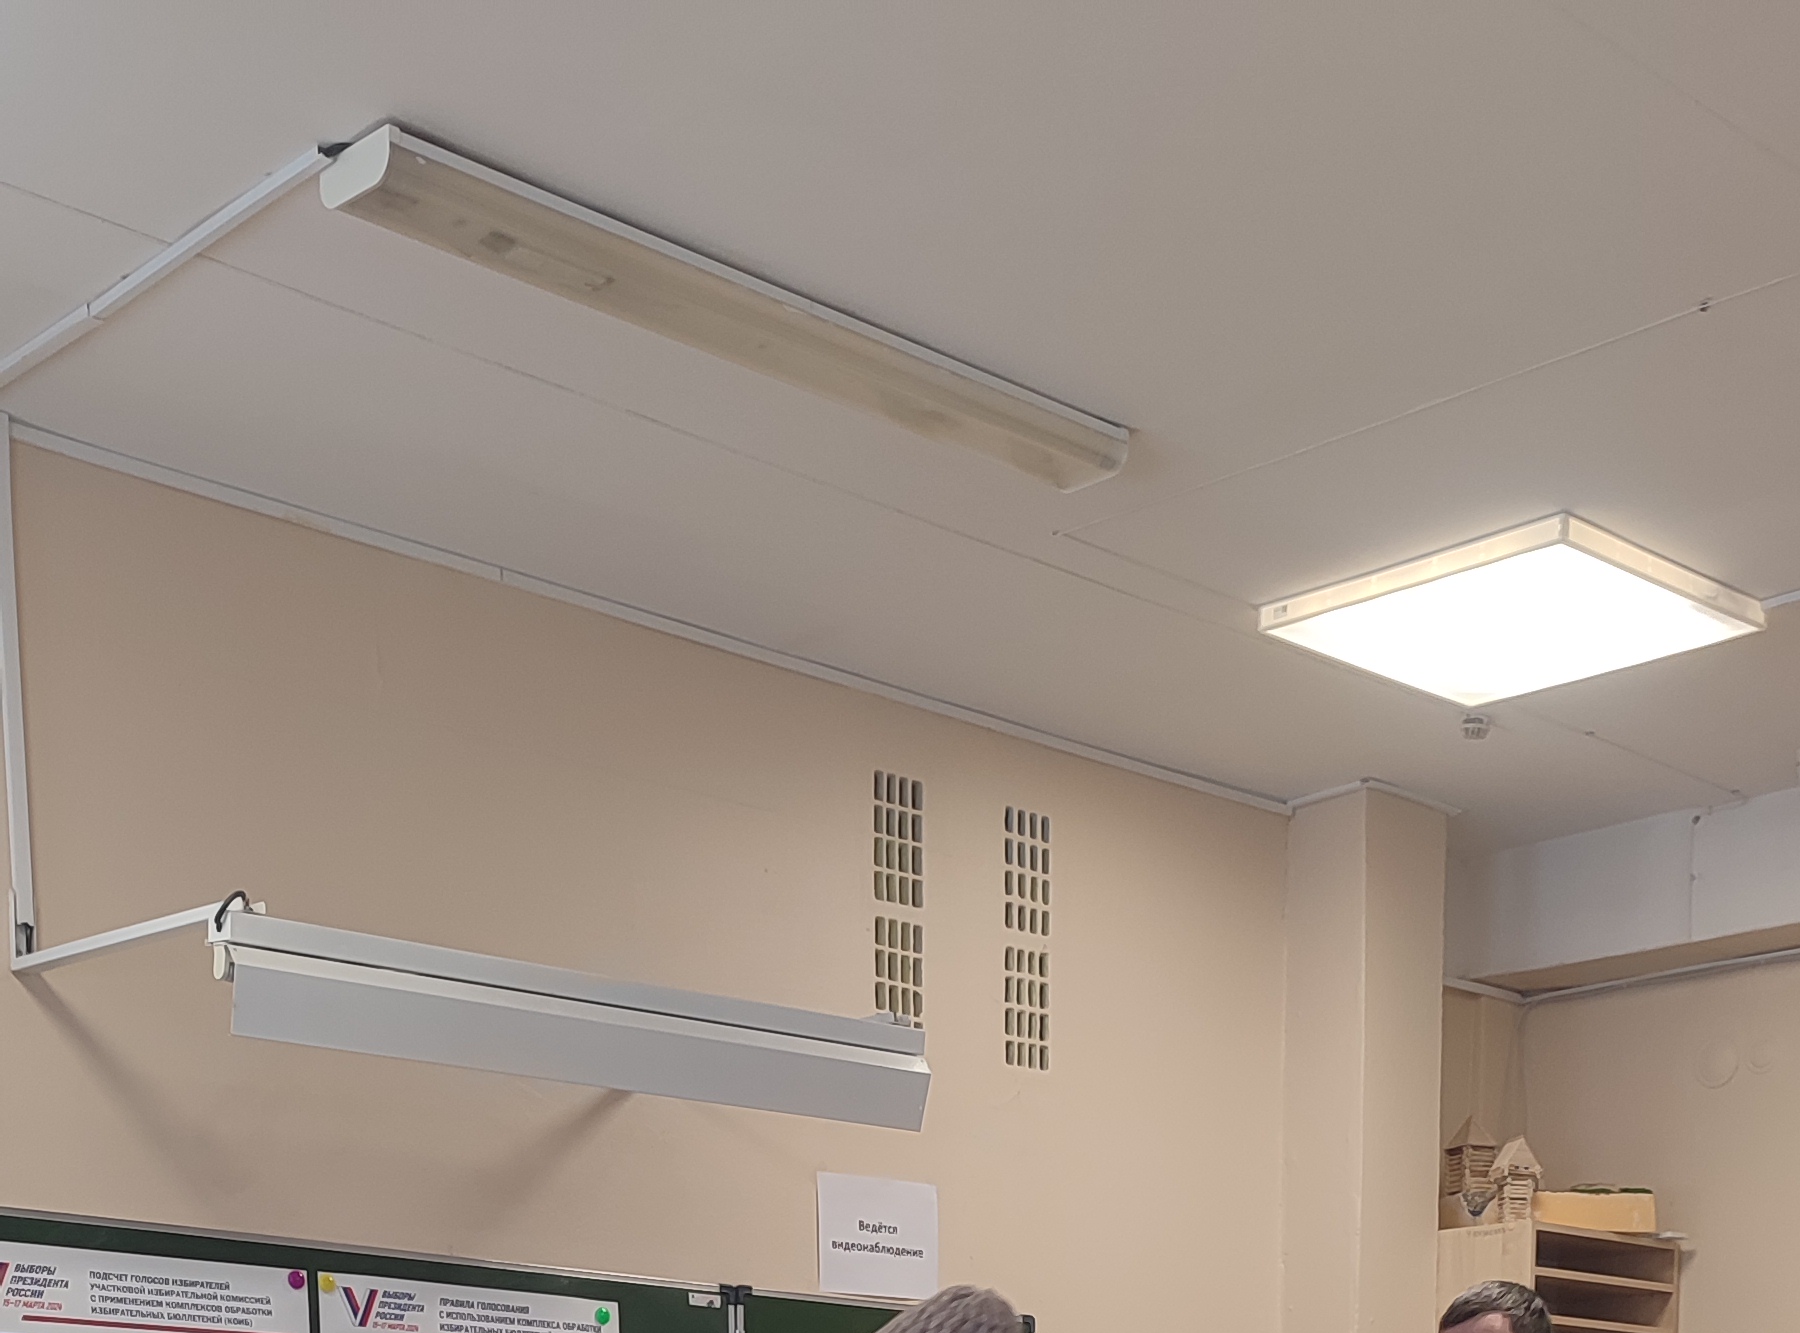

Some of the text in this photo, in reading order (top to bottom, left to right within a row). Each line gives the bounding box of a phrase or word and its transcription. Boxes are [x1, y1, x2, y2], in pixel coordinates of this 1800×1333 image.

[858, 1219, 898, 1235] Ведётся
[831, 1240, 924, 1258] видеонаблюдение
[14, 1263, 57, 1276] ВЫБОРЫ
[9, 1275, 70, 1289] ПРЕЗИДЕНТА
[89, 1270, 230, 1290] ПОДСЧЕТ ГОЛОСОВ ИЗБИРАТЕЛЕЙ
[5, 1287, 45, 1299] РОССИИ
[89, 1283, 271, 1305] УЧАСТКОВОЙ ИЗБИРАТЕЛЬНОЙ КОМИССИЕЙ
[382, 1290, 416, 1301] ВЫБОРЫ
[98, 1295, 163, 1308] ПРИМЕНЕНИЕМ
[165, 1300, 222, 1313] КОМПЛЕКСОВ
[224, 1306, 272, 1317] ОБРАБОТКИ
[378, 1300, 425, 1312] ПРЕЗИДЕНТА
[439, 1297, 530, 1314] ПРАВИЛА ГОЛОСОВАНИЯ
[90, 1306, 252, 1327] ИЗБИРАТЕЛЬНЫХ БЮЛЛЕТЕНЕЙ (КОИБ)
[375, 1311, 405, 1321] РОССИИ
[439, 1311, 602, 1333] С ИСПОЛЬЗОВАНИЕМ КОМПЛЕКСА ОБРАБОТКИ
